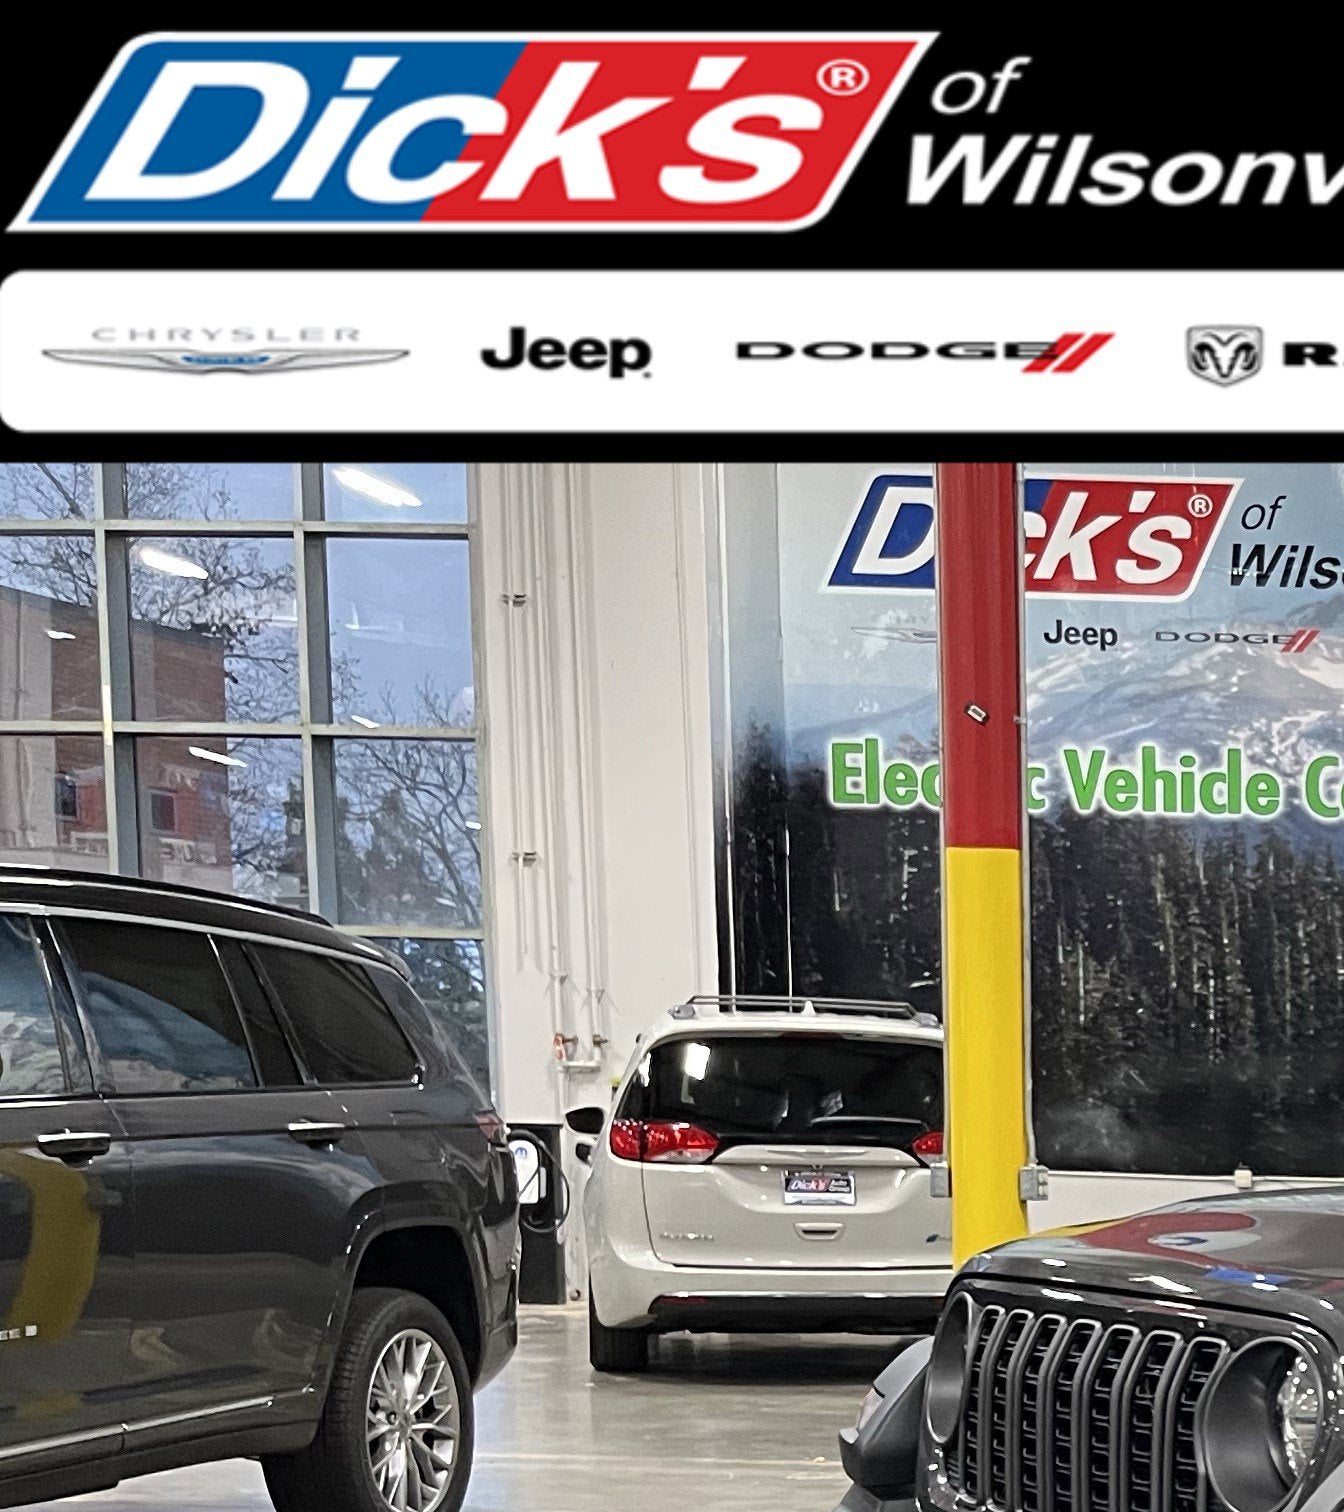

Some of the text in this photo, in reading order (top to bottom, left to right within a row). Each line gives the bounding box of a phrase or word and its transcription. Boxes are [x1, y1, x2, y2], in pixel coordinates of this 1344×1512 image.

[852, 486, 1287, 585] Dk's of
[1043, 619, 1119, 652] Jeep
[1155, 630, 1298, 646] DODGE
[831, 737, 1047, 811] Elecc
[1064, 745, 1281, 815] Vehicle
